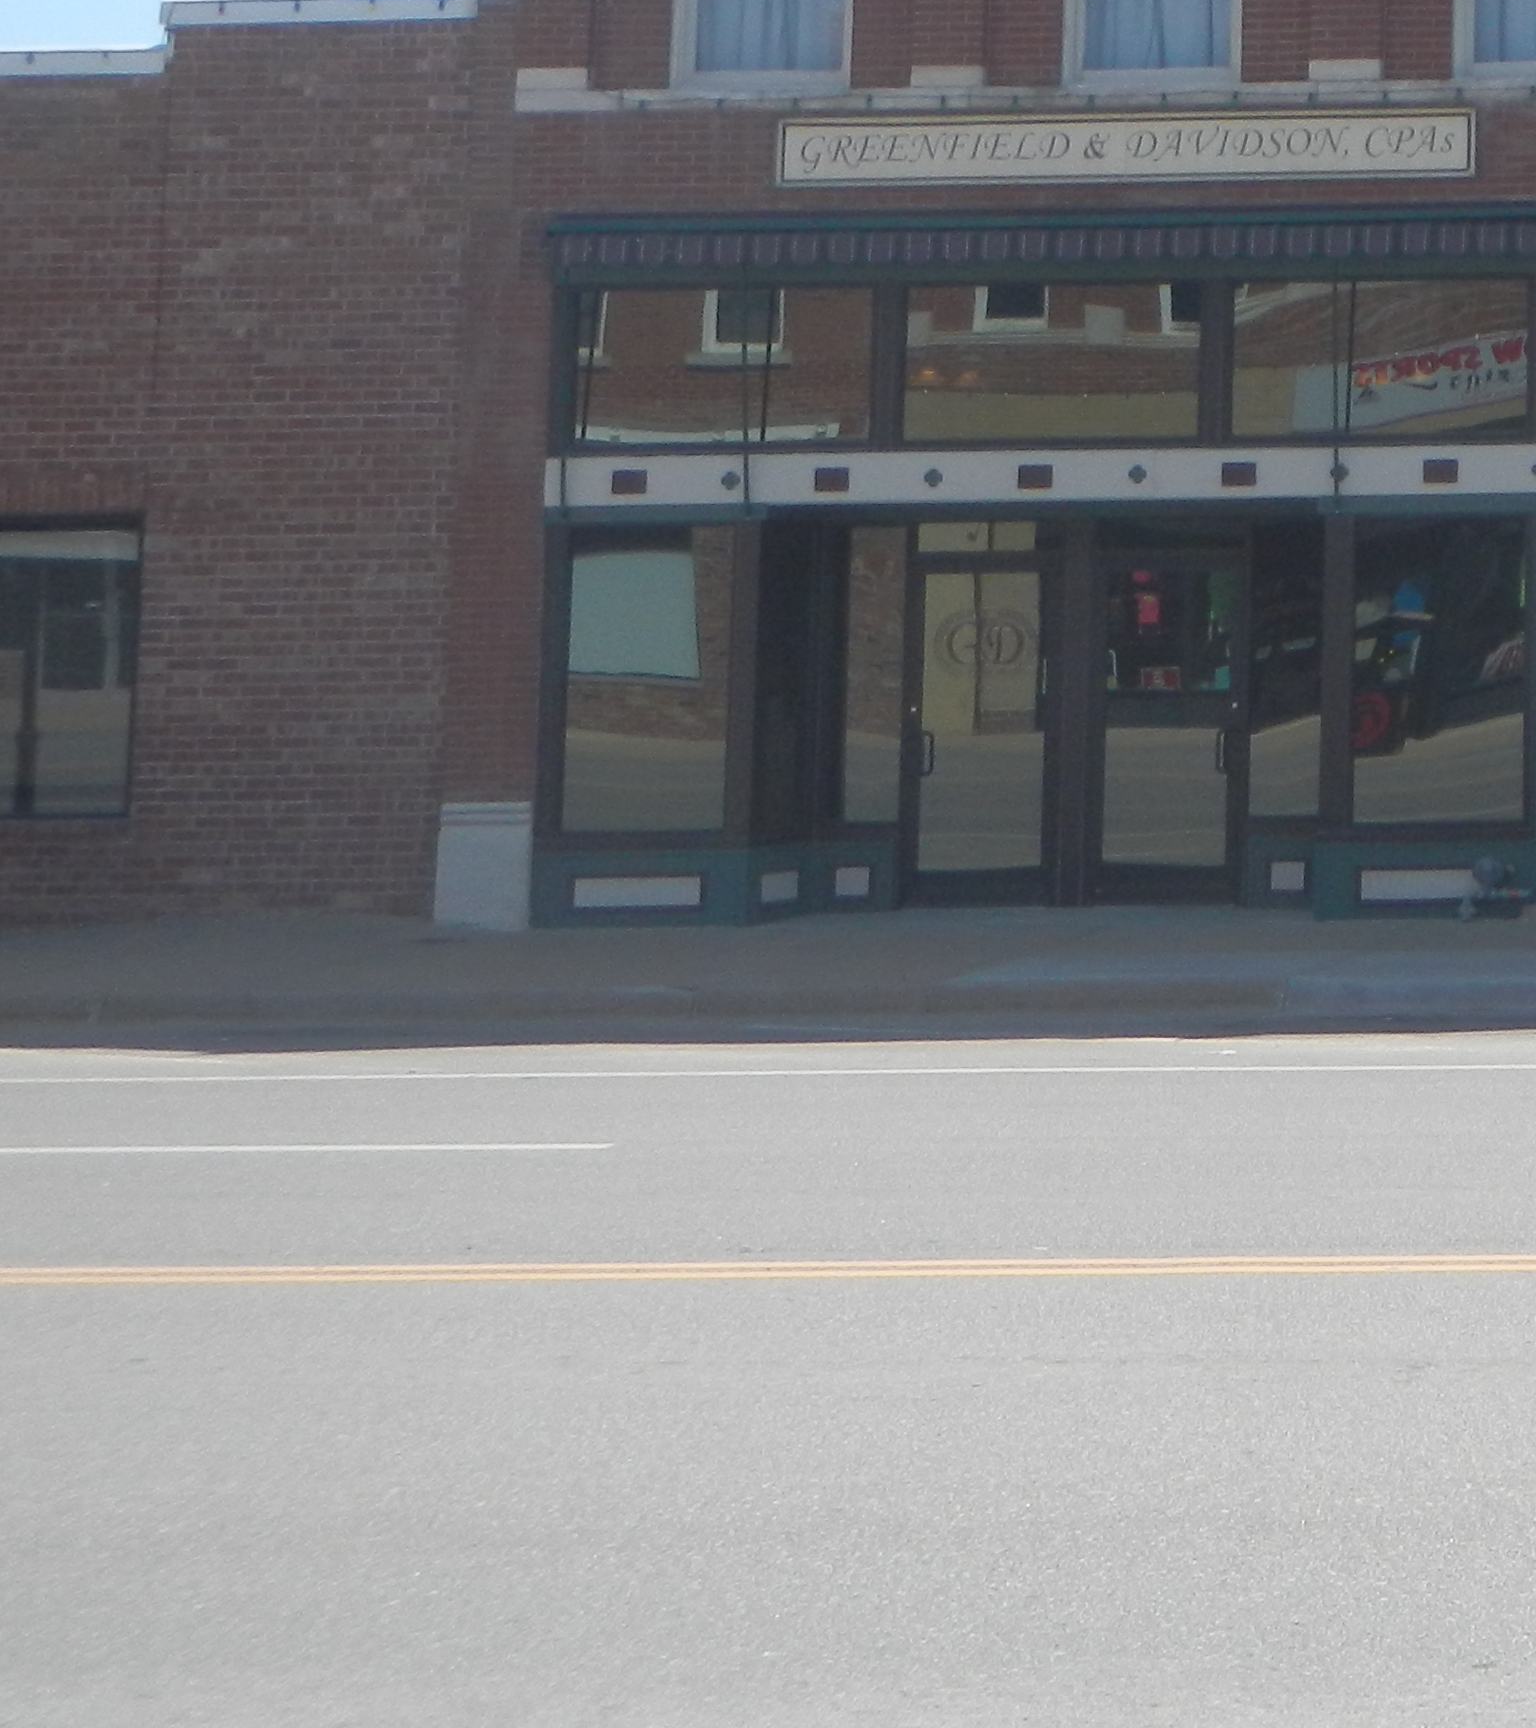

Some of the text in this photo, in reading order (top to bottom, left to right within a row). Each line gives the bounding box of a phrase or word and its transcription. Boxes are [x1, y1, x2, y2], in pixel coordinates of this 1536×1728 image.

[799, 126, 1455, 173] GREENFIELD & DAVIDSON, CPAs
